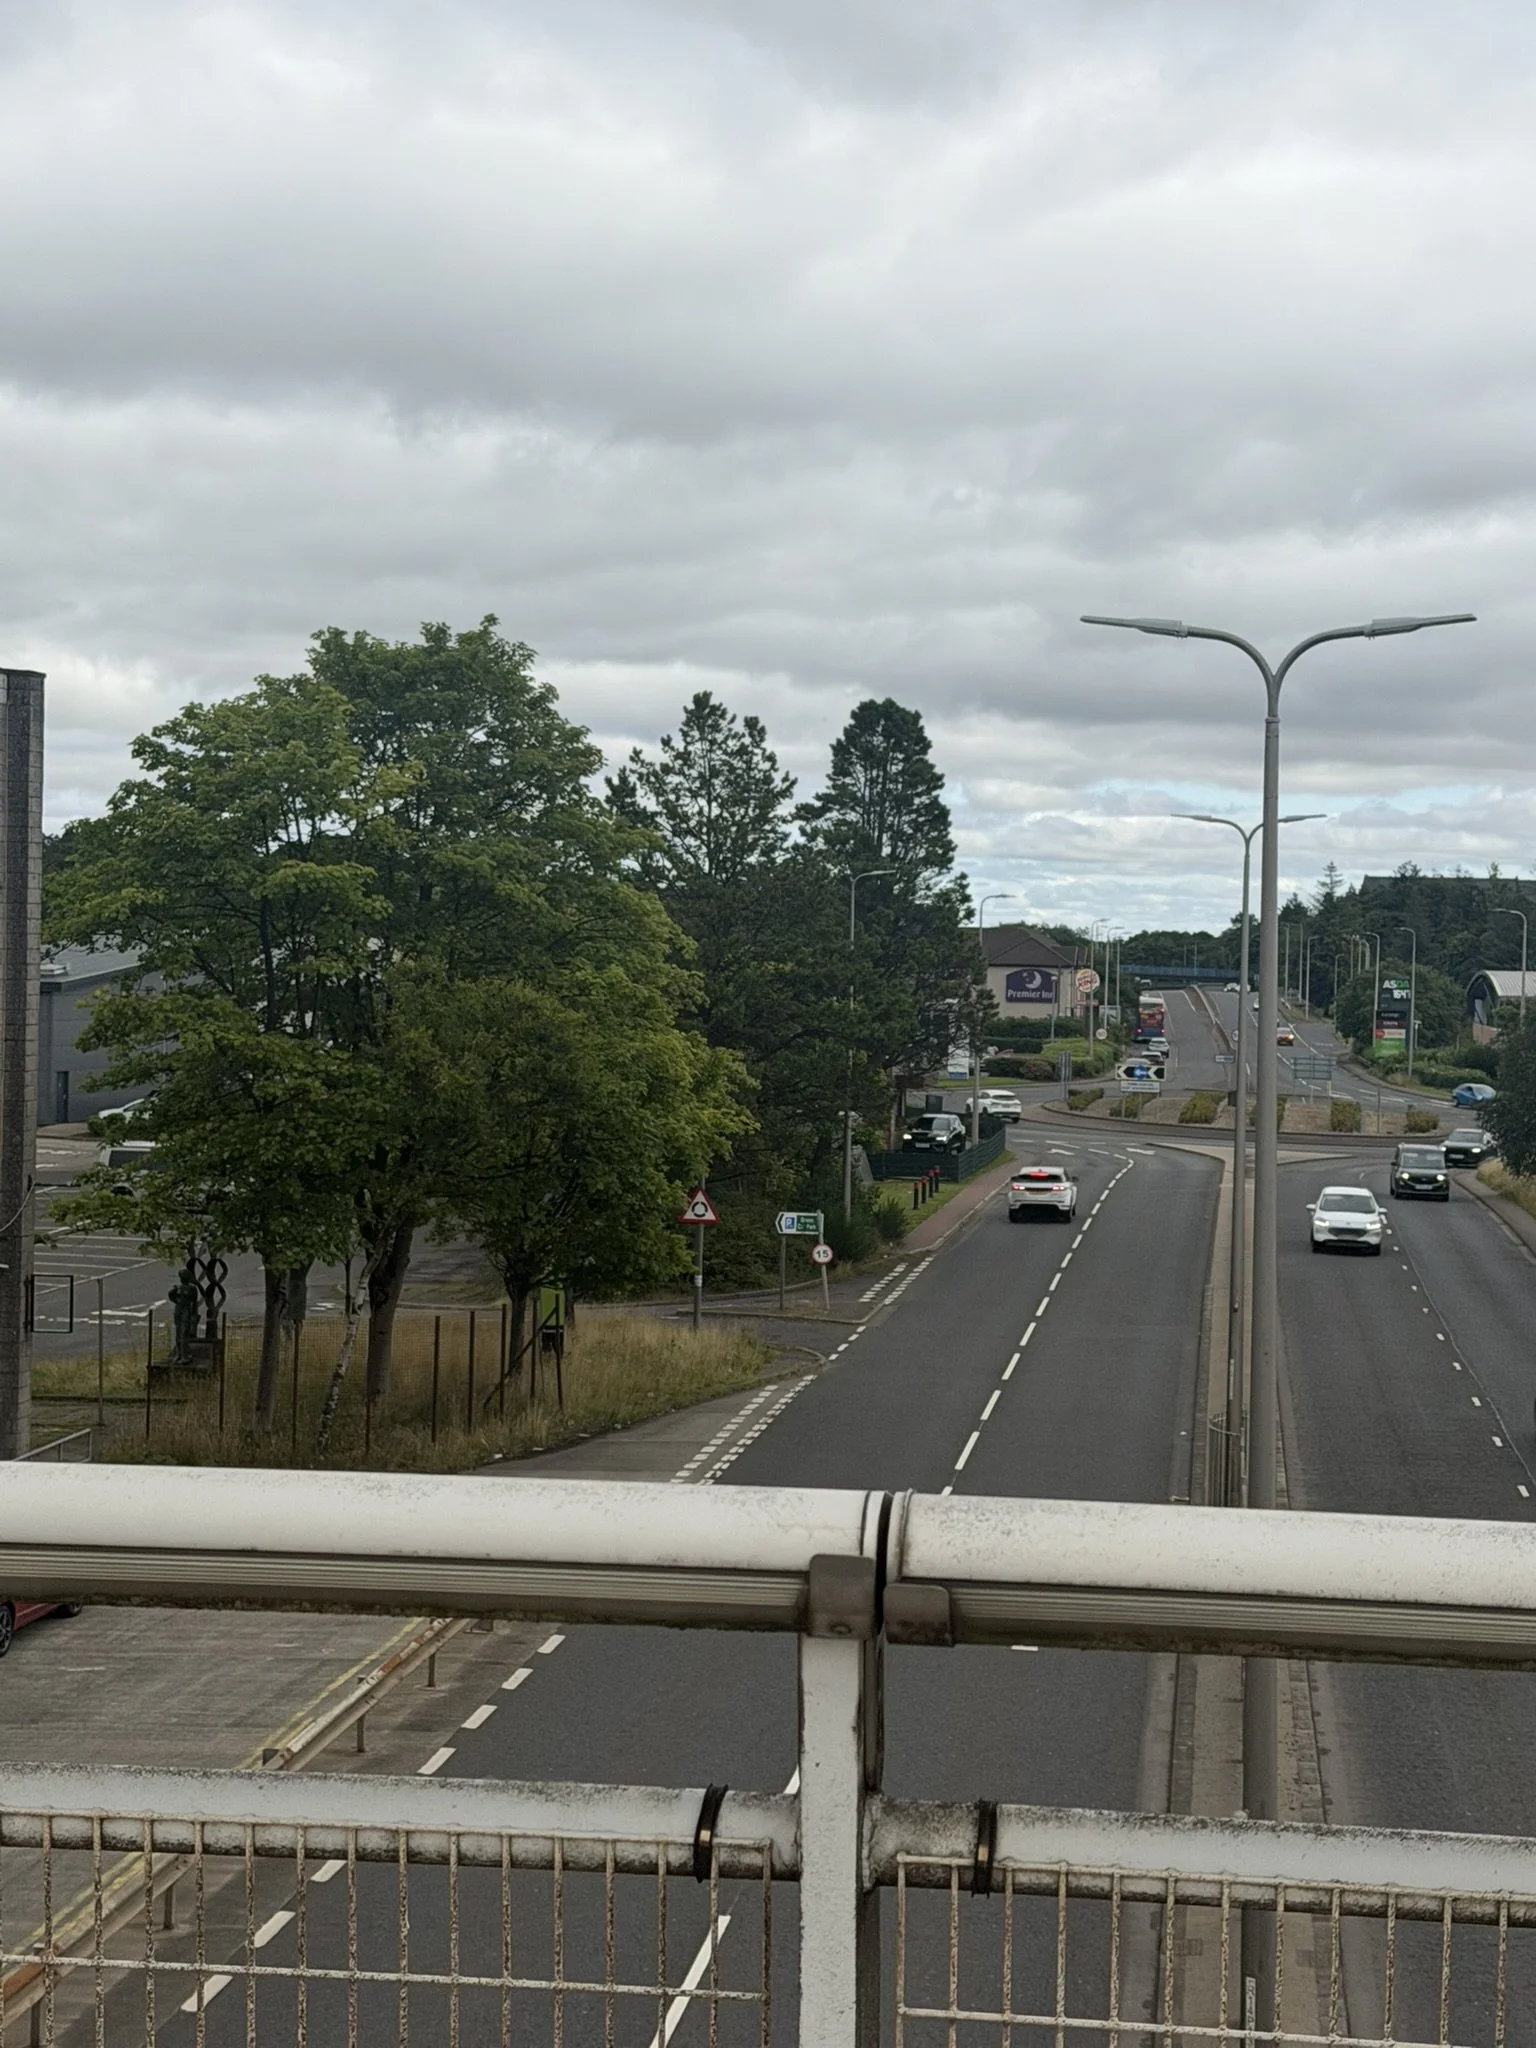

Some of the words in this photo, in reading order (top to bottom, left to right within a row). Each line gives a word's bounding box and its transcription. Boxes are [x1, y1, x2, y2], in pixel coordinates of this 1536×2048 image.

[1383, 980, 1409, 989] ASDA
[1008, 989, 1041, 998] Premier
[816, 1249, 829, 1259] 15
